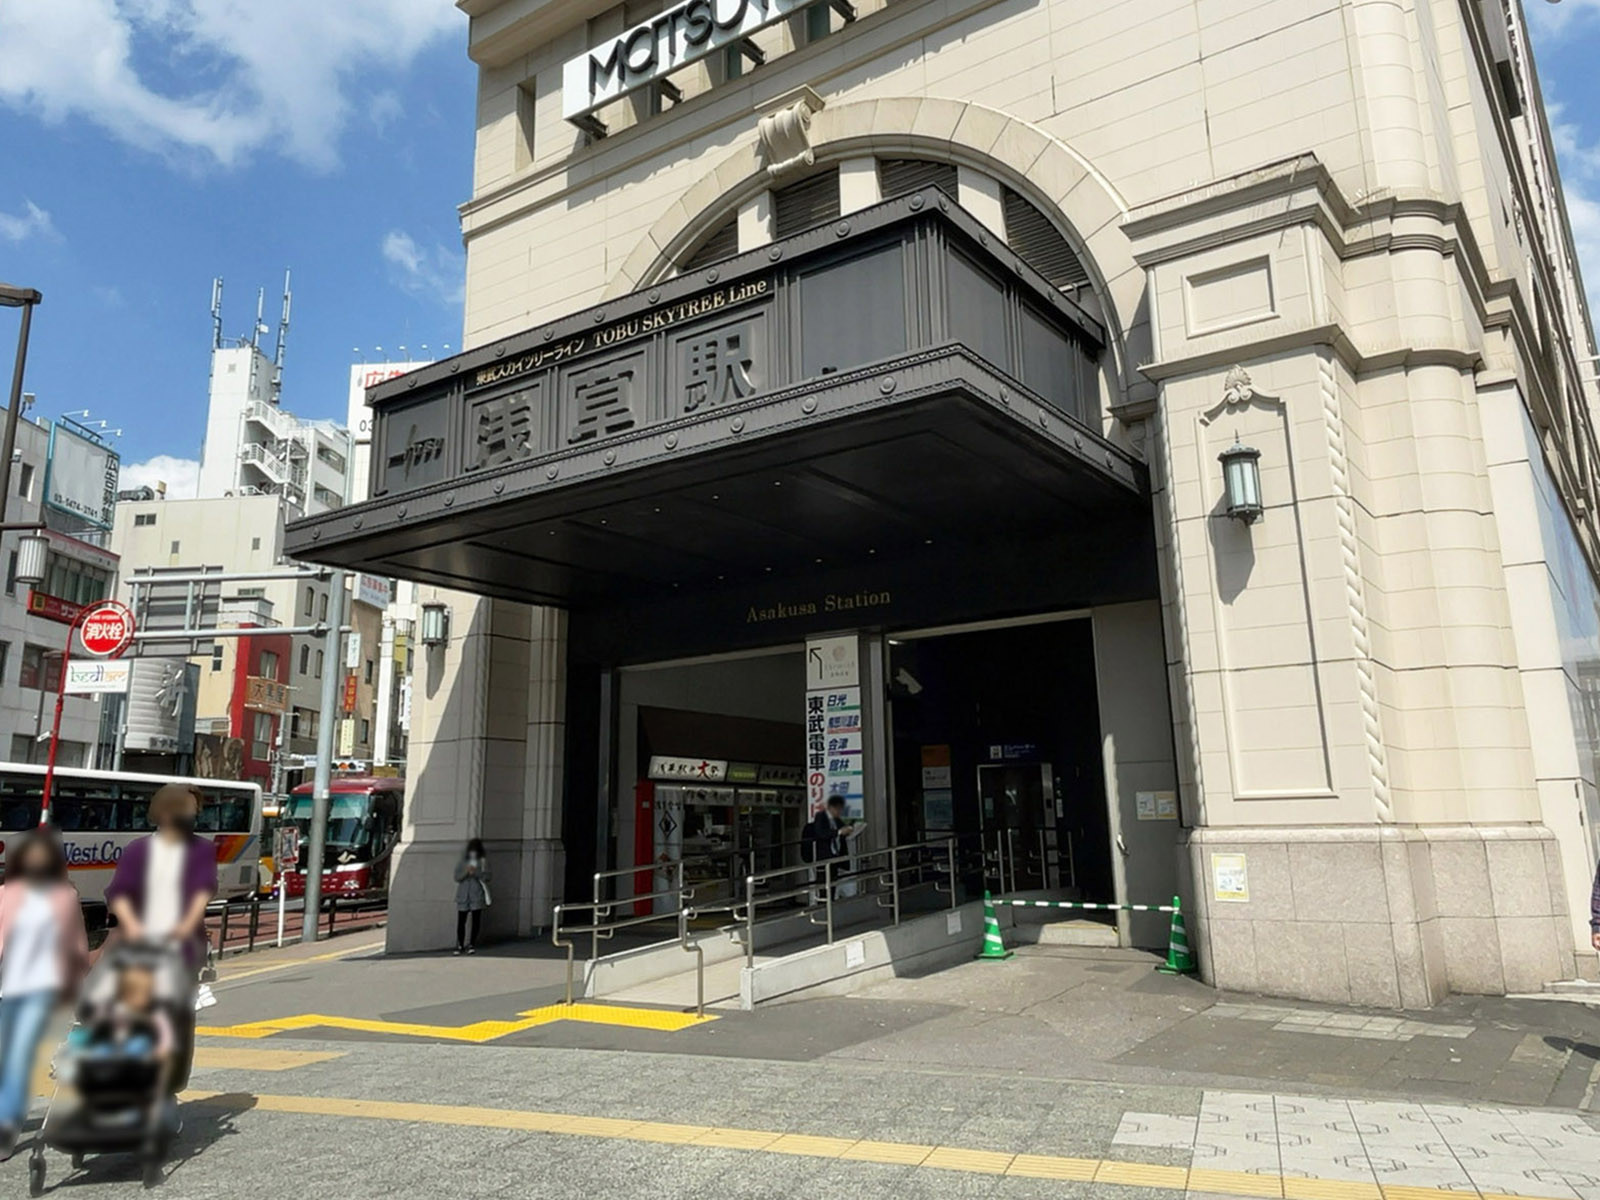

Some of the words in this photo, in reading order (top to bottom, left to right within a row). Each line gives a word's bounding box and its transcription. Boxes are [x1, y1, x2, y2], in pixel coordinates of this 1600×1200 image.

[588, 0, 770, 97] MATSU
[476, 337, 586, 386] 東武スカイツリーライン
[593, 318, 640, 348] TOBU
[642, 290, 726, 332] SKYTREE
[728, 279, 768, 303] Line
[745, 601, 818, 624] Asakusa
[824, 589, 892, 613] Station
[85, 622, 123, 640] 消火栓
[827, 694, 848, 707] 日光
[829, 738, 849, 751] 会津
